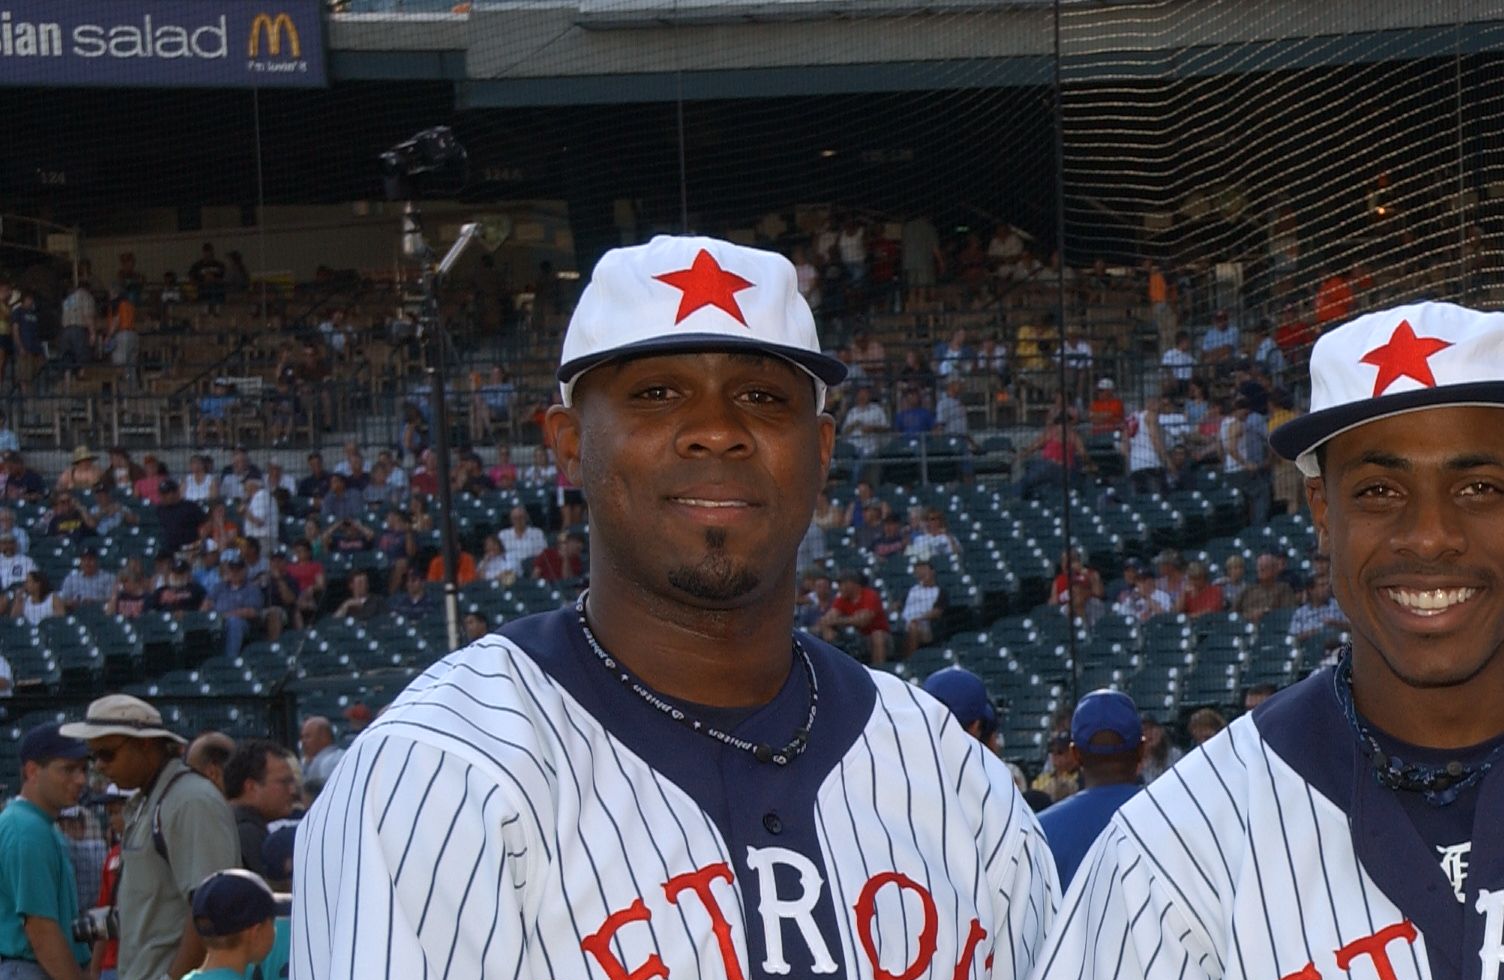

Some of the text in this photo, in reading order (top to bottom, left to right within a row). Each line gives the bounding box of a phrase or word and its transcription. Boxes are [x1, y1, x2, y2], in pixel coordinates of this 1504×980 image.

[0, 11, 229, 58] ian salad
[633, 684, 671, 713] phiten
[708, 728, 754, 751] phiten
